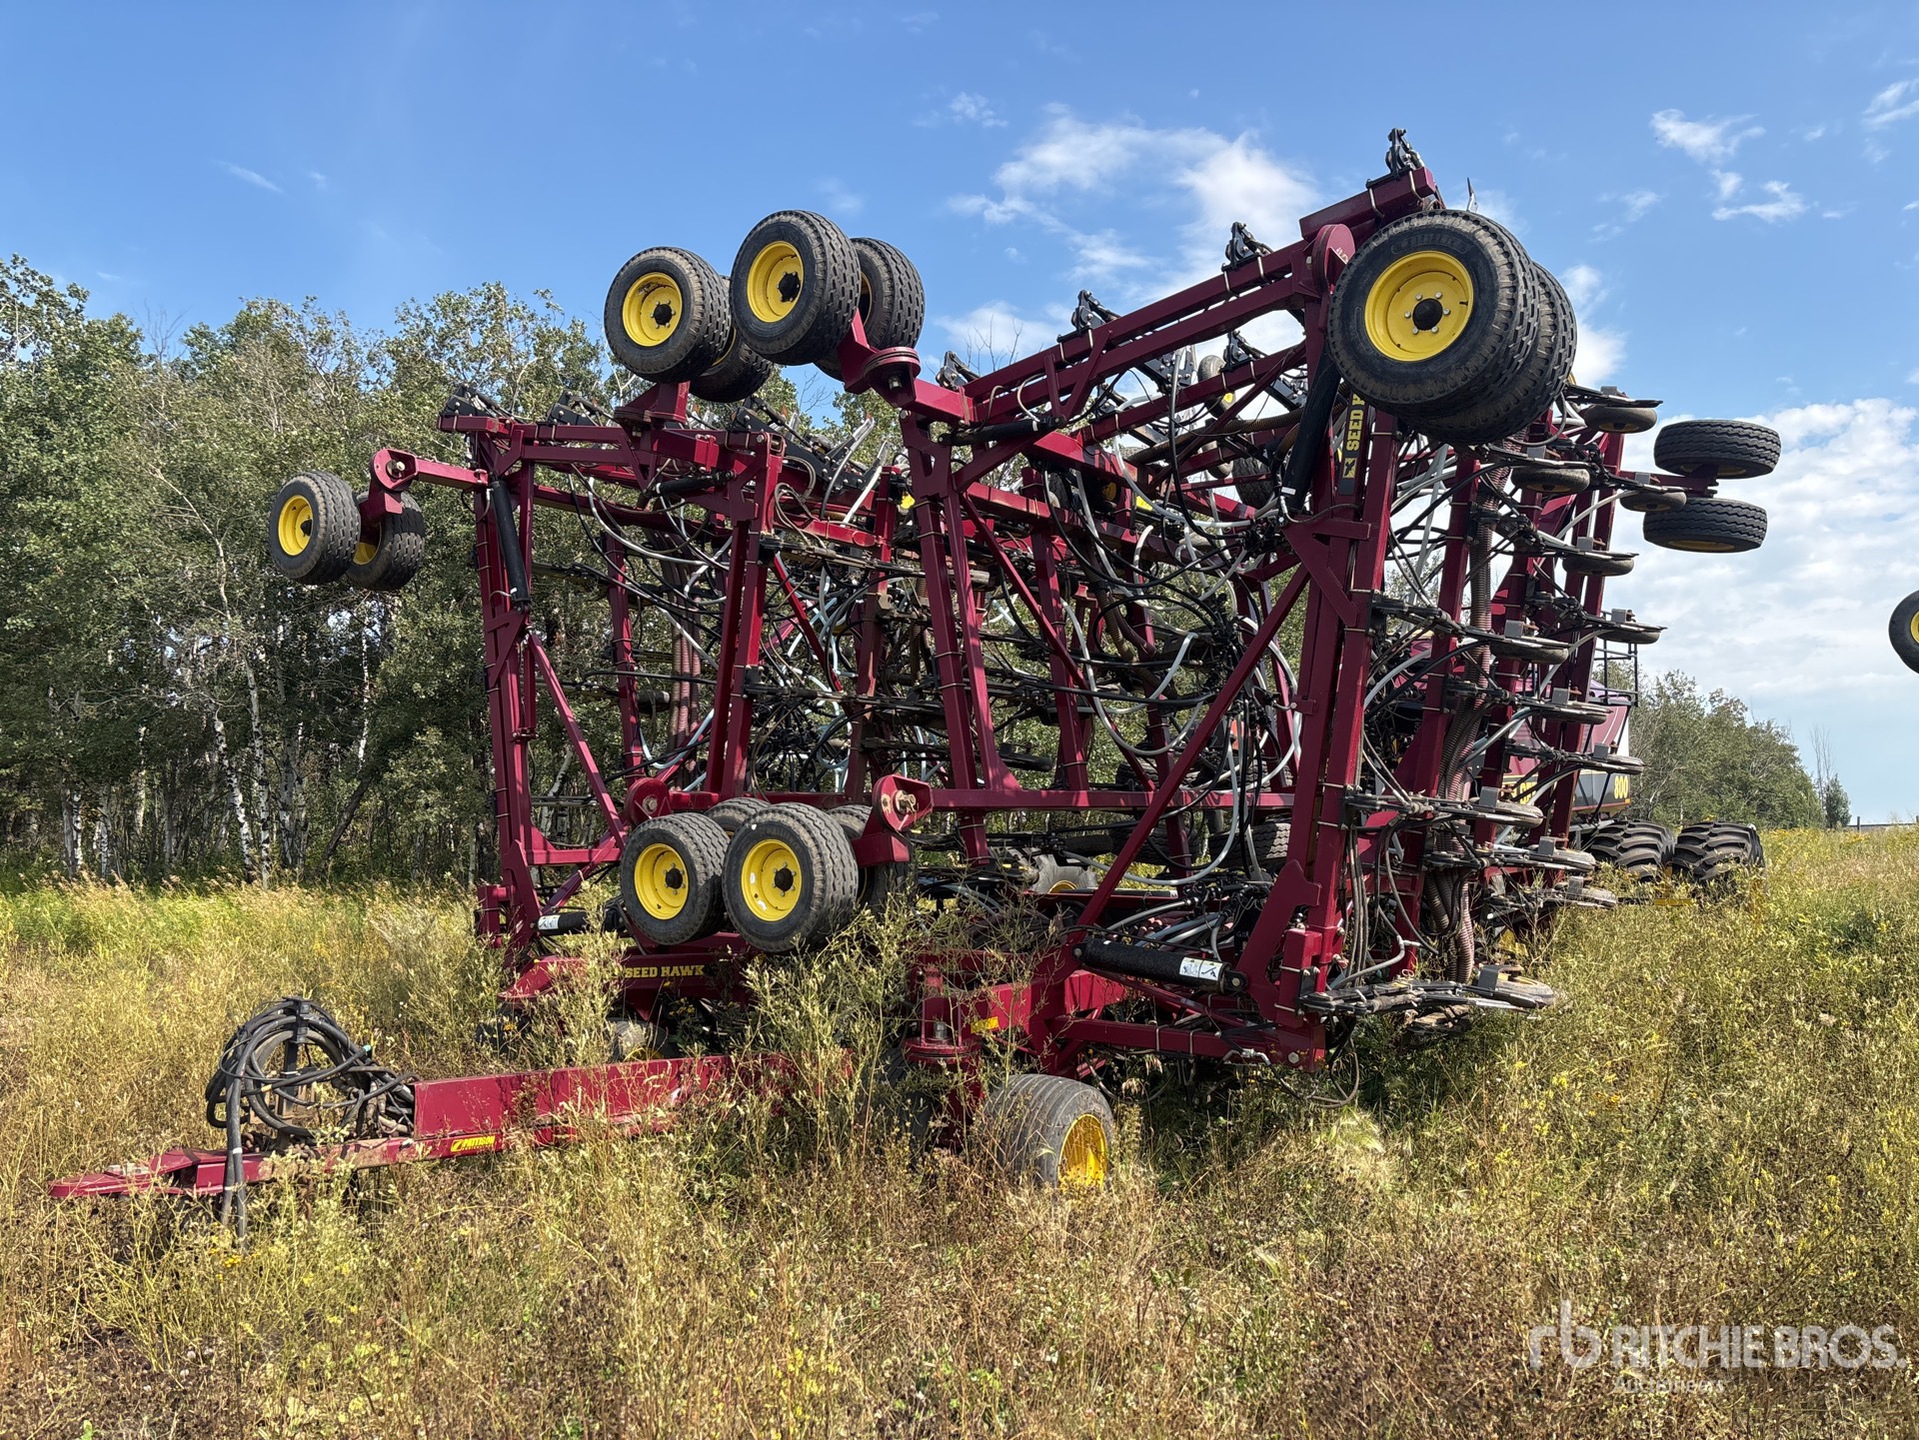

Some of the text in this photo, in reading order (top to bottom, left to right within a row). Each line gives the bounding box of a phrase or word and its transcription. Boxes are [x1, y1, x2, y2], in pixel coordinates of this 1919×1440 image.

[1346, 409, 1364, 451] SEED
[1614, 775, 1629, 799] 800
[625, 965, 705, 978] SEED HAWK
